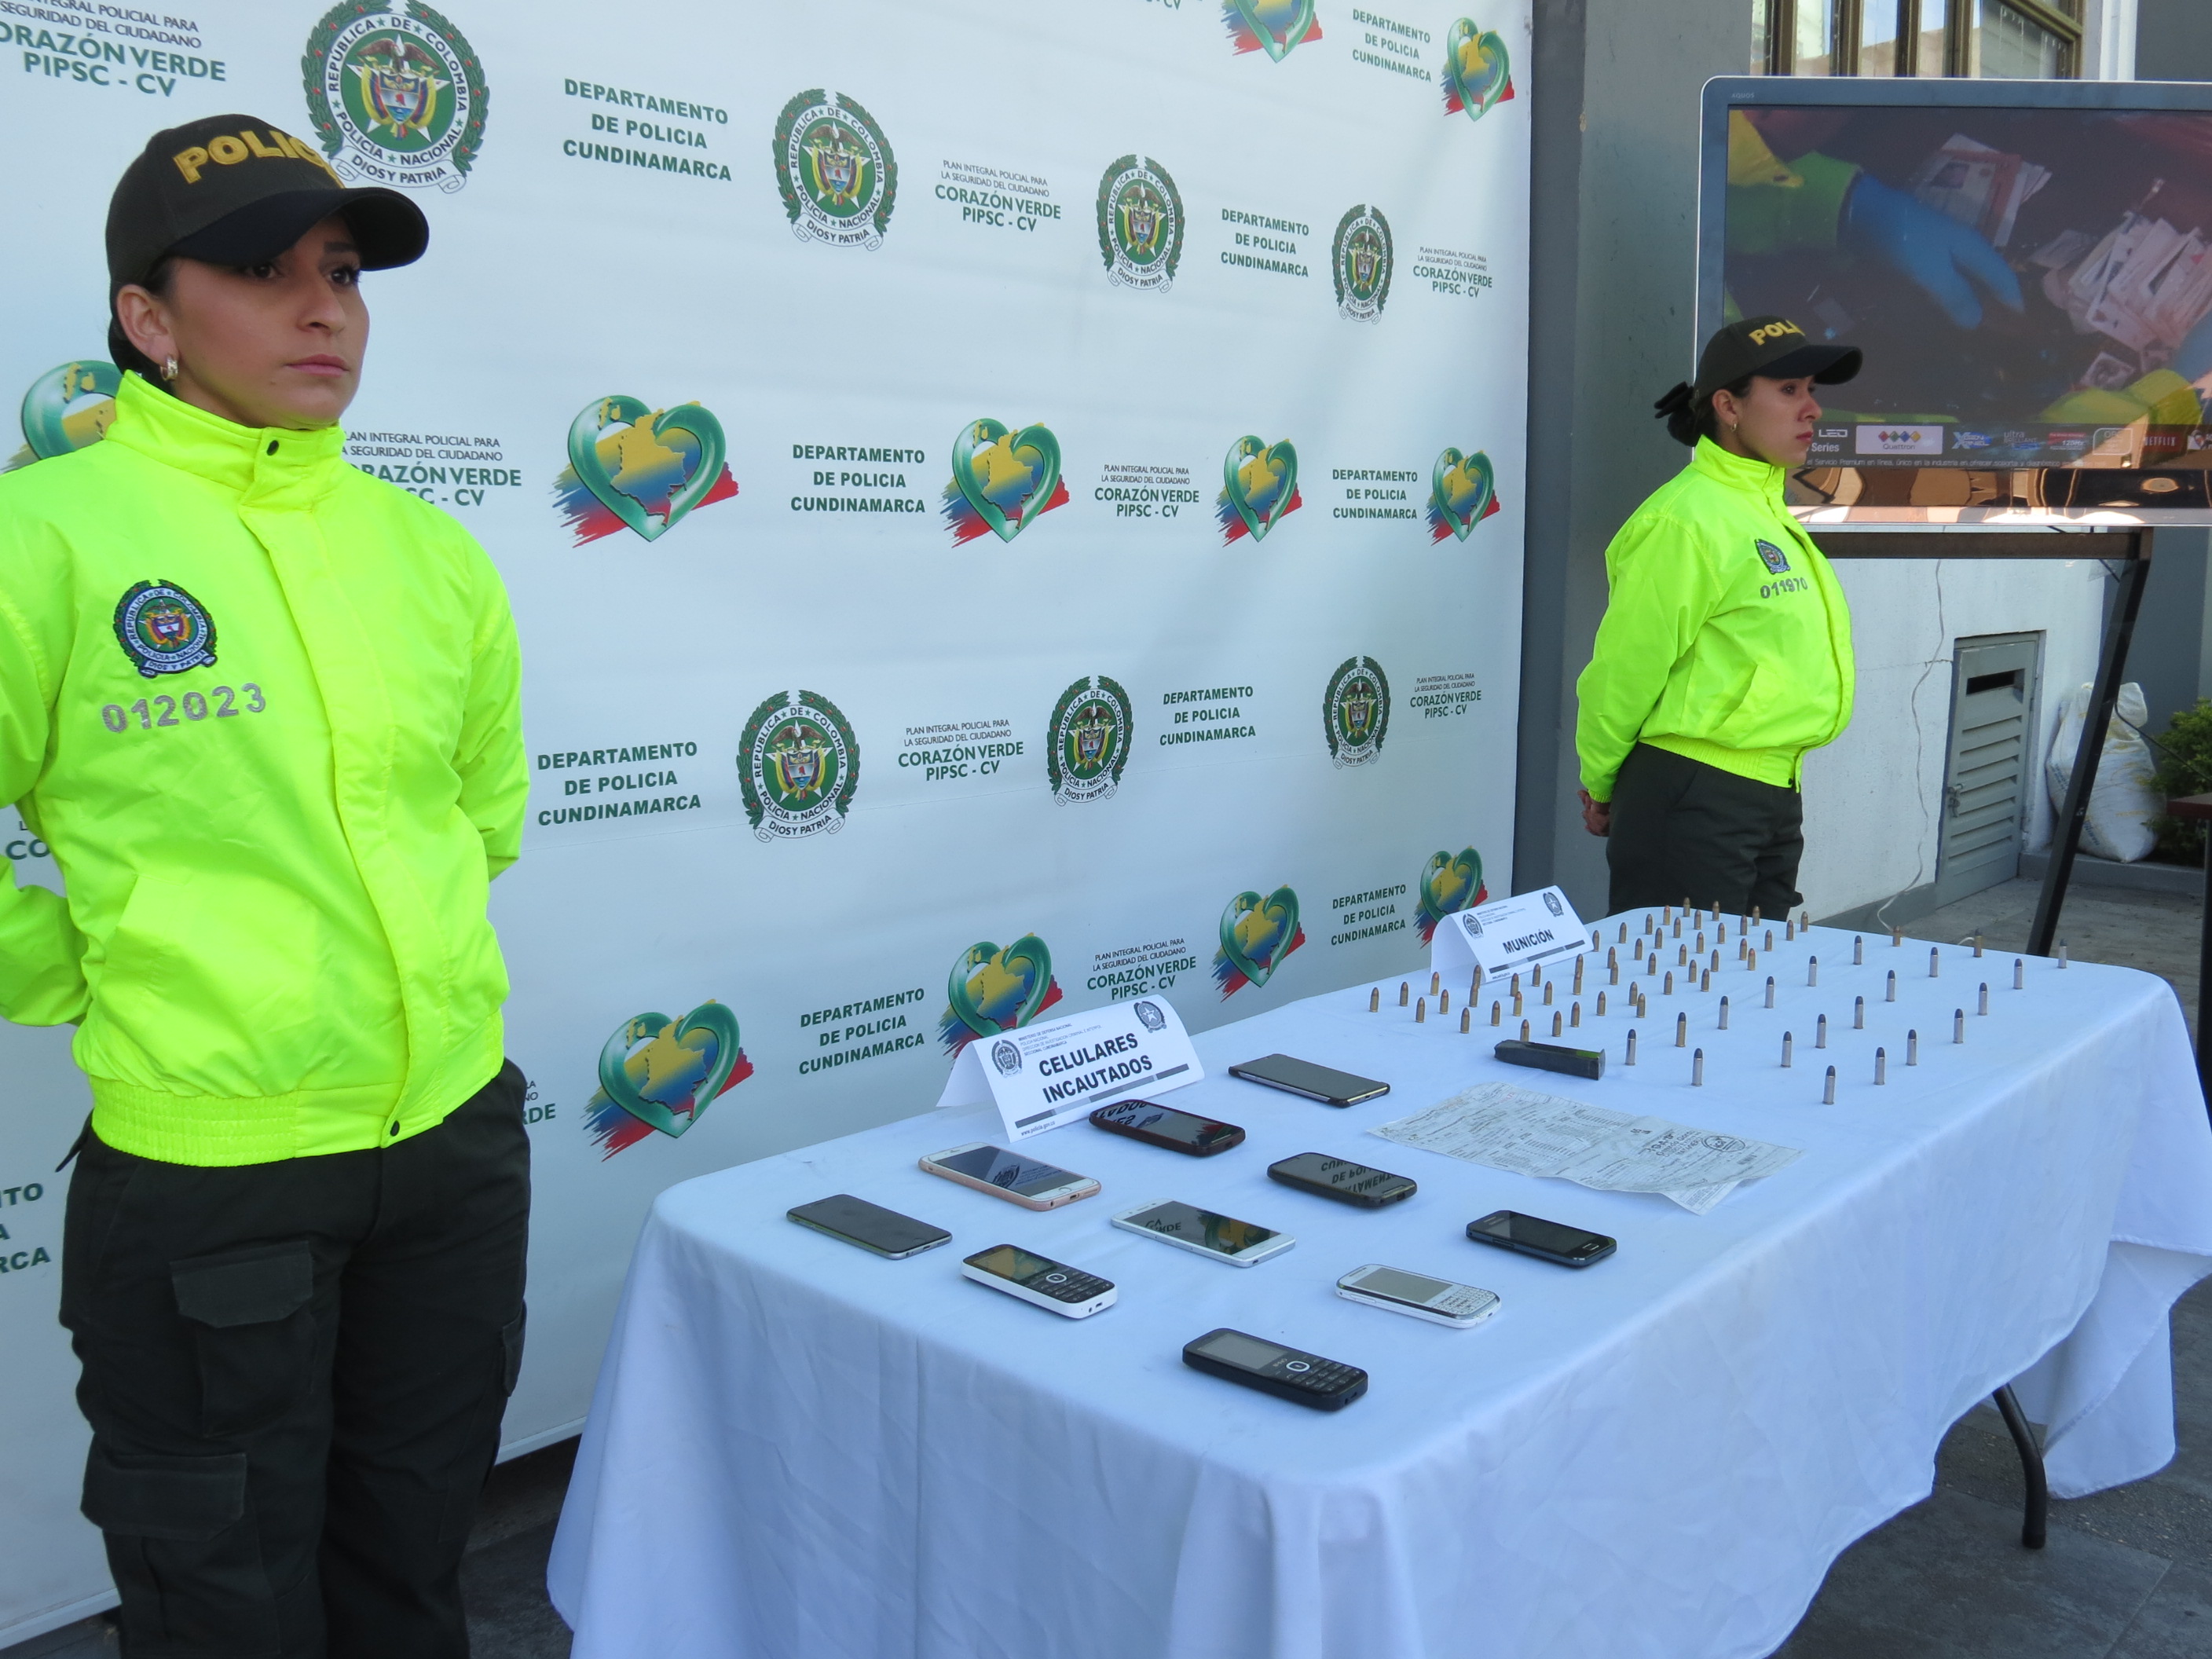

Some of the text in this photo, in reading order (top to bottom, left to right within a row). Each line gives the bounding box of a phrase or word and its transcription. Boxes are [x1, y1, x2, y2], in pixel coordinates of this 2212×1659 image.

[0, 1, 202, 48] SEGURIDAD DEL CIUDADANO
[99, 4, 160, 26] POLICIAL
[164, 16, 199, 32] PARA
[1353, 9, 1430, 44] DEPARTAMENTO
[1364, 32, 1419, 60] DE POLICIA
[24, 51, 176, 97] PIPSC CV
[129, 46, 226, 82] VERDE
[391, 16, 412, 31] DE
[426, 32, 467, 112] COLOMBIA
[1352, 49, 1432, 82] CUNDINAMARCA
[564, 79, 728, 125] DEPARTAMENTO
[591, 113, 708, 148] DE POLICIA
[400, 128, 462, 166] NACIONAL
[563, 139, 732, 181] CUNDINAMARCA
[943, 159, 1048, 186] PLAN INTEGRAL POLICIAL PARA
[400, 167, 446, 184] PATRIA
[941, 170, 1049, 197] LA SEGURIDAD DEL CIUDADANO
[935, 184, 1061, 219] CORAZÓN VERDE
[963, 207, 1037, 232] PIPSC CV
[1221, 208, 1309, 236] DEPARTAMENTO
[1236, 233, 1296, 255] DE POLICIA
[1221, 251, 1309, 277] CUNDINAMARCA
[1412, 266, 1492, 288] CORAZÓN VERDE
[1432, 280, 1480, 298] PIPSC CV
[370, 432, 423, 445] INTEGRAL
[425, 435, 472, 447] POLICIAL
[474, 437, 500, 448] PARA
[1818, 429, 1848, 438] LED
[350, 445, 504, 461] SEGURIDAD DEL CIUDADANO
[793, 445, 925, 463] DEPARTAMENTO
[1811, 442, 1840, 452] Series
[449, 467, 522, 486] VERDE
[814, 471, 906, 488] DE POLICIA
[1332, 469, 1418, 482] DEPARTAMENTO
[454, 489, 485, 507] CV
[791, 496, 925, 513] CUNDINAMARCA
[1094, 485, 1199, 503] CORAZÓN VERDE
[1346, 489, 1407, 500] DE POLICIA
[1117, 504, 1179, 518] PIPSC CV
[1333, 507, 1417, 519] CUNDINAMARCA
[1760, 577, 1807, 599] 011970
[1163, 686, 1254, 705] DEPARTAMENTO
[1410, 690, 1481, 708] CORAZÓN VERDE
[101, 683, 266, 734] 012023
[1174, 707, 1240, 724] DE POLICIA
[1425, 704, 1467, 719] PIPSC CV
[790, 707, 804, 716] DE
[813, 712, 846, 769] COLOMBIA
[904, 729, 1012, 747] LA SEGURIDAD DEL CIUDADANO
[926, 723, 960, 734] INTEGRAL
[961, 721, 991, 731] POLICIAL
[993, 719, 1009, 727] PARA
[1159, 725, 1256, 746] CUNDINAMARCA
[537, 742, 698, 771] DEPARTAMENTO
[898, 742, 1024, 767] CORAZÓN VERDE
[565, 771, 678, 796] DE POLICIA
[926, 760, 1000, 782] PIPSC CV
[538, 794, 701, 826] CUNDINAMARCA
[800, 782, 844, 820] NACIONAL
[800, 815, 832, 835] PATRIA
[1332, 884, 1406, 910] DEPARTAMENTO
[1343, 904, 1395, 925] DE POLICIA
[1331, 919, 1406, 946] CUNDINAMARCA
[1503, 928, 1555, 954] MUNICIÓN
[1087, 956, 1196, 990] CORAZÓN VERDE
[1111, 975, 1176, 1000] PIPSC CV
[800, 987, 925, 1027] DEPARTAMENTO
[820, 1015, 906, 1046] DE POLICIA
[799, 1033, 925, 1075] CUNDINAMARCA
[1038, 1033, 1138, 1078] CELULARES
[1042, 1054, 1153, 1104] INCAUTADOS
